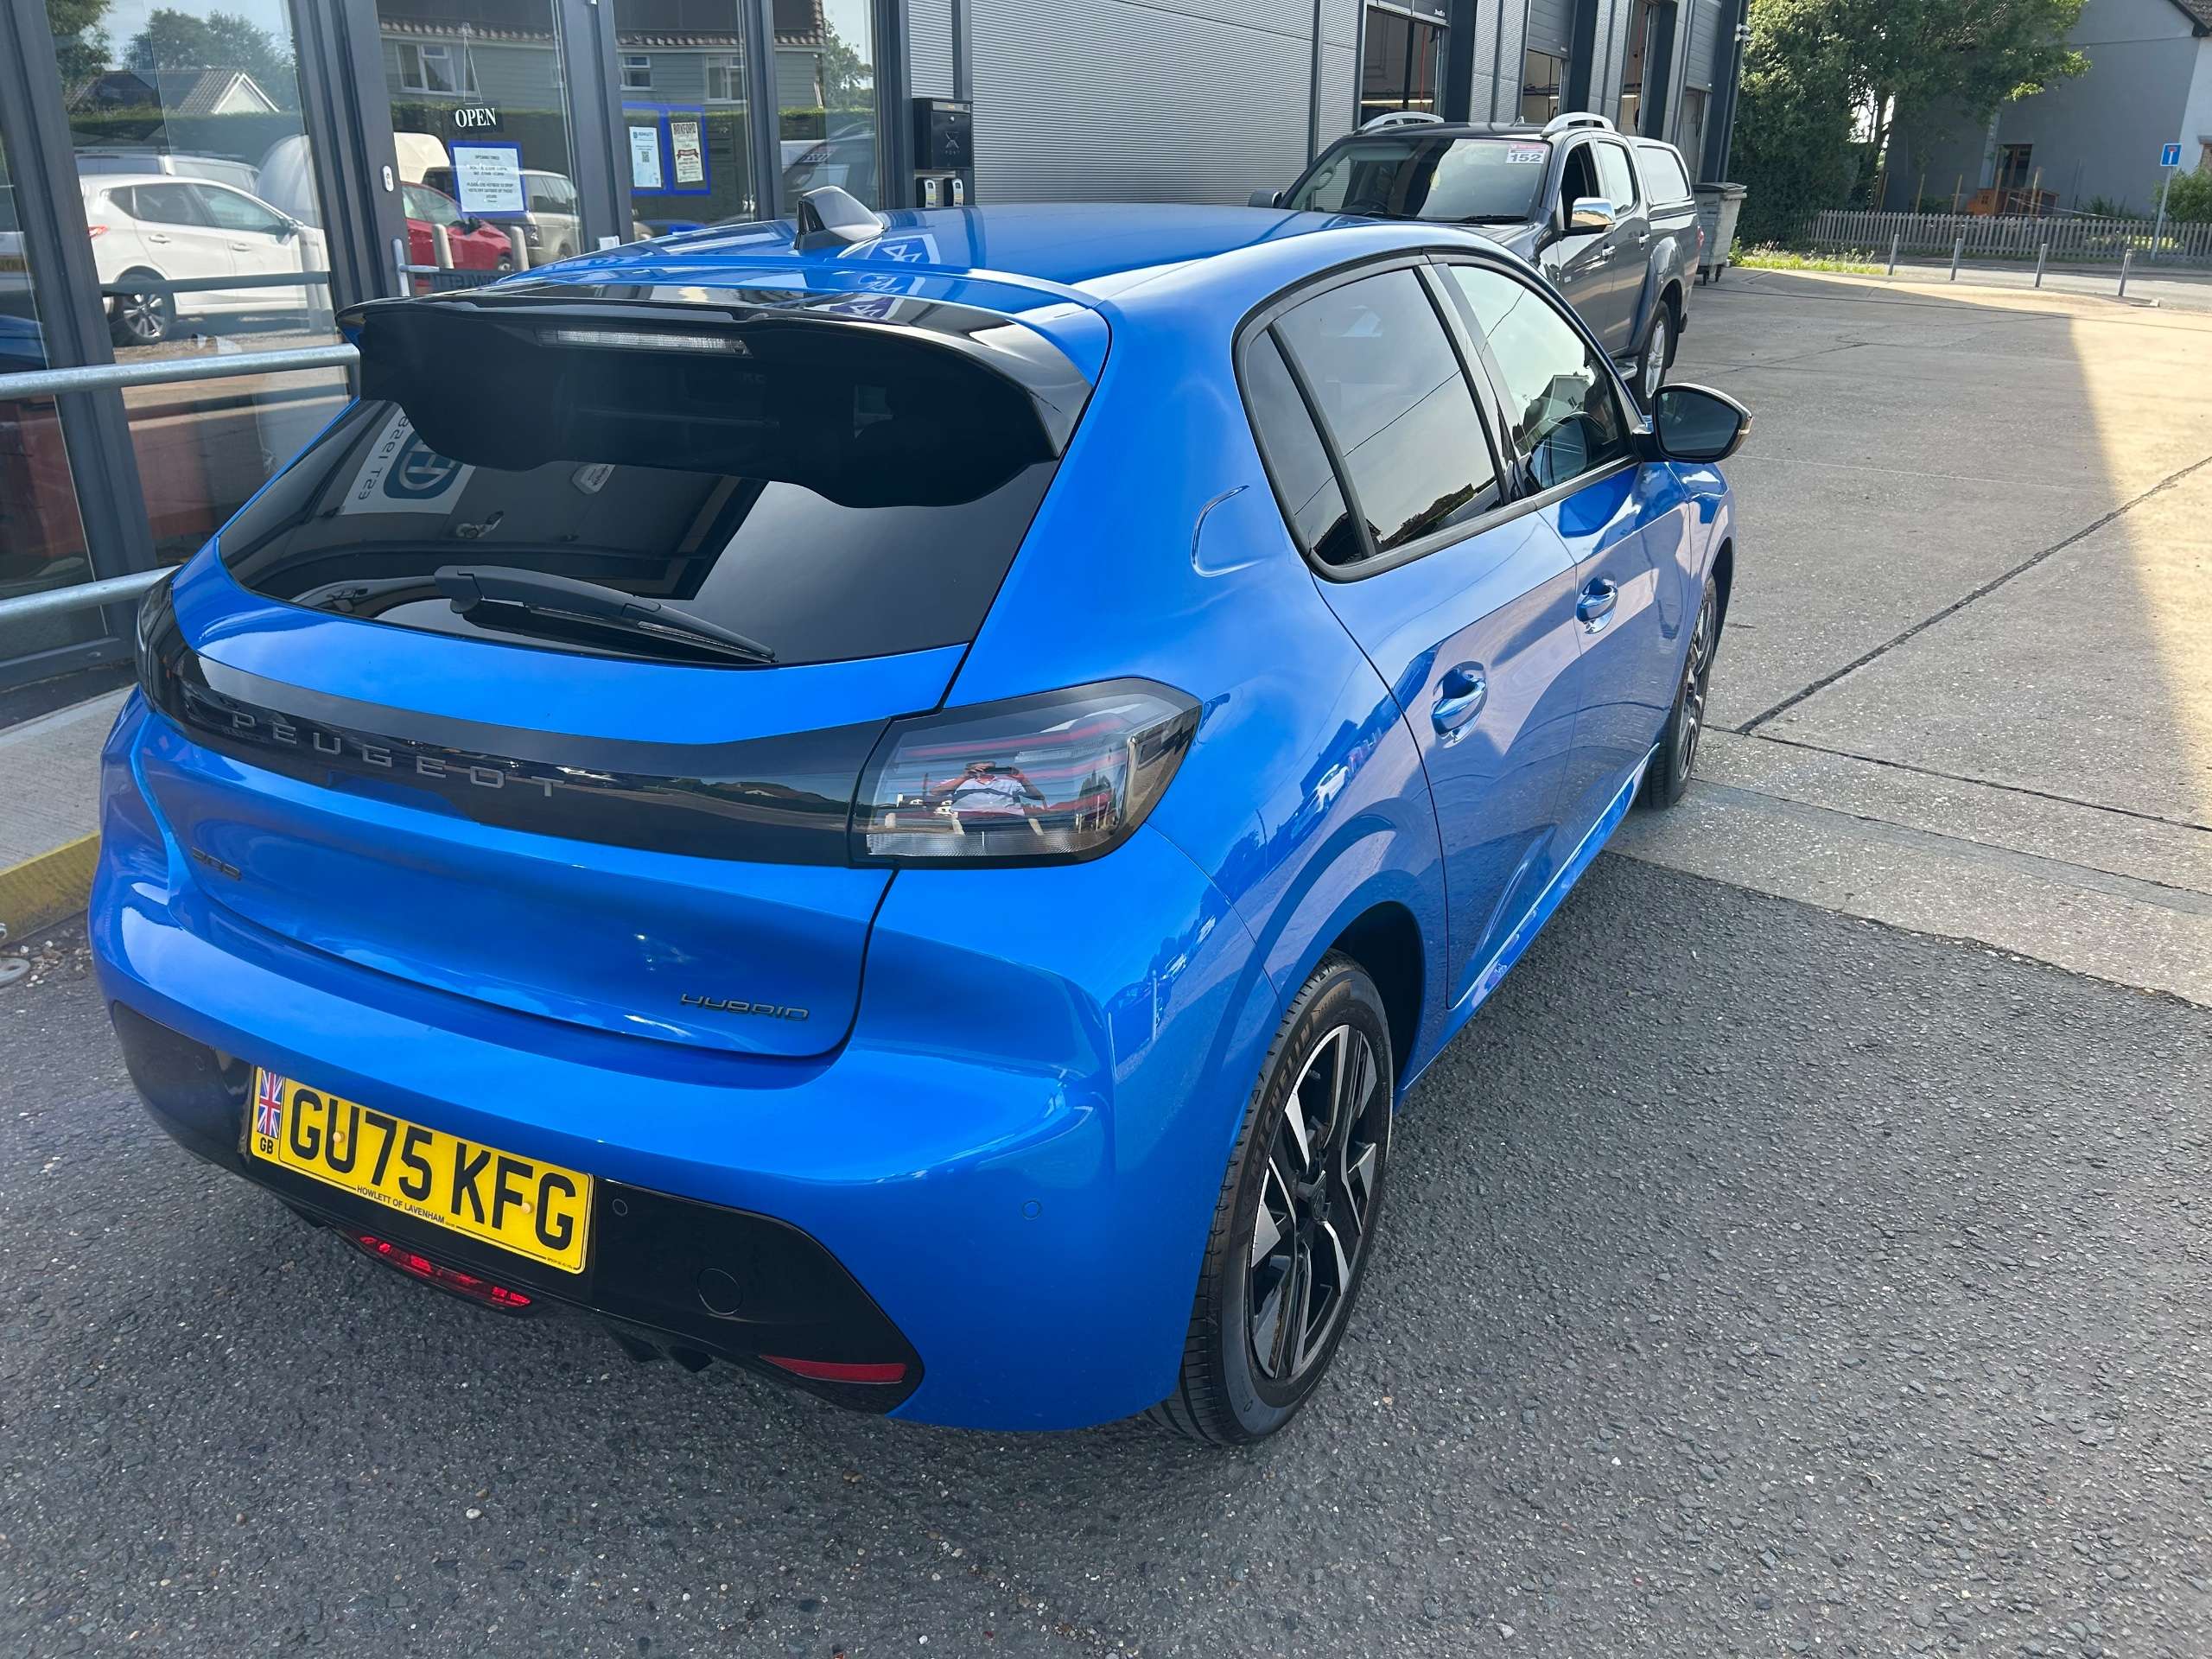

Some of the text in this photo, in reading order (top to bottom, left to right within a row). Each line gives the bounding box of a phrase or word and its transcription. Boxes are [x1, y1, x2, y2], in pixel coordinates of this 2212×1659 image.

[454, 107, 498, 128] OPEN
[1510, 153, 1542, 162] 152
[232, 709, 566, 798] PEUGEOT
[680, 993, 810, 1020] HYBRID
[258, 1135, 275, 1156] GB
[289, 1087, 577, 1252] GU75 KFG
[356, 1185, 446, 1224] HOWLETT OF LAVENHAM
